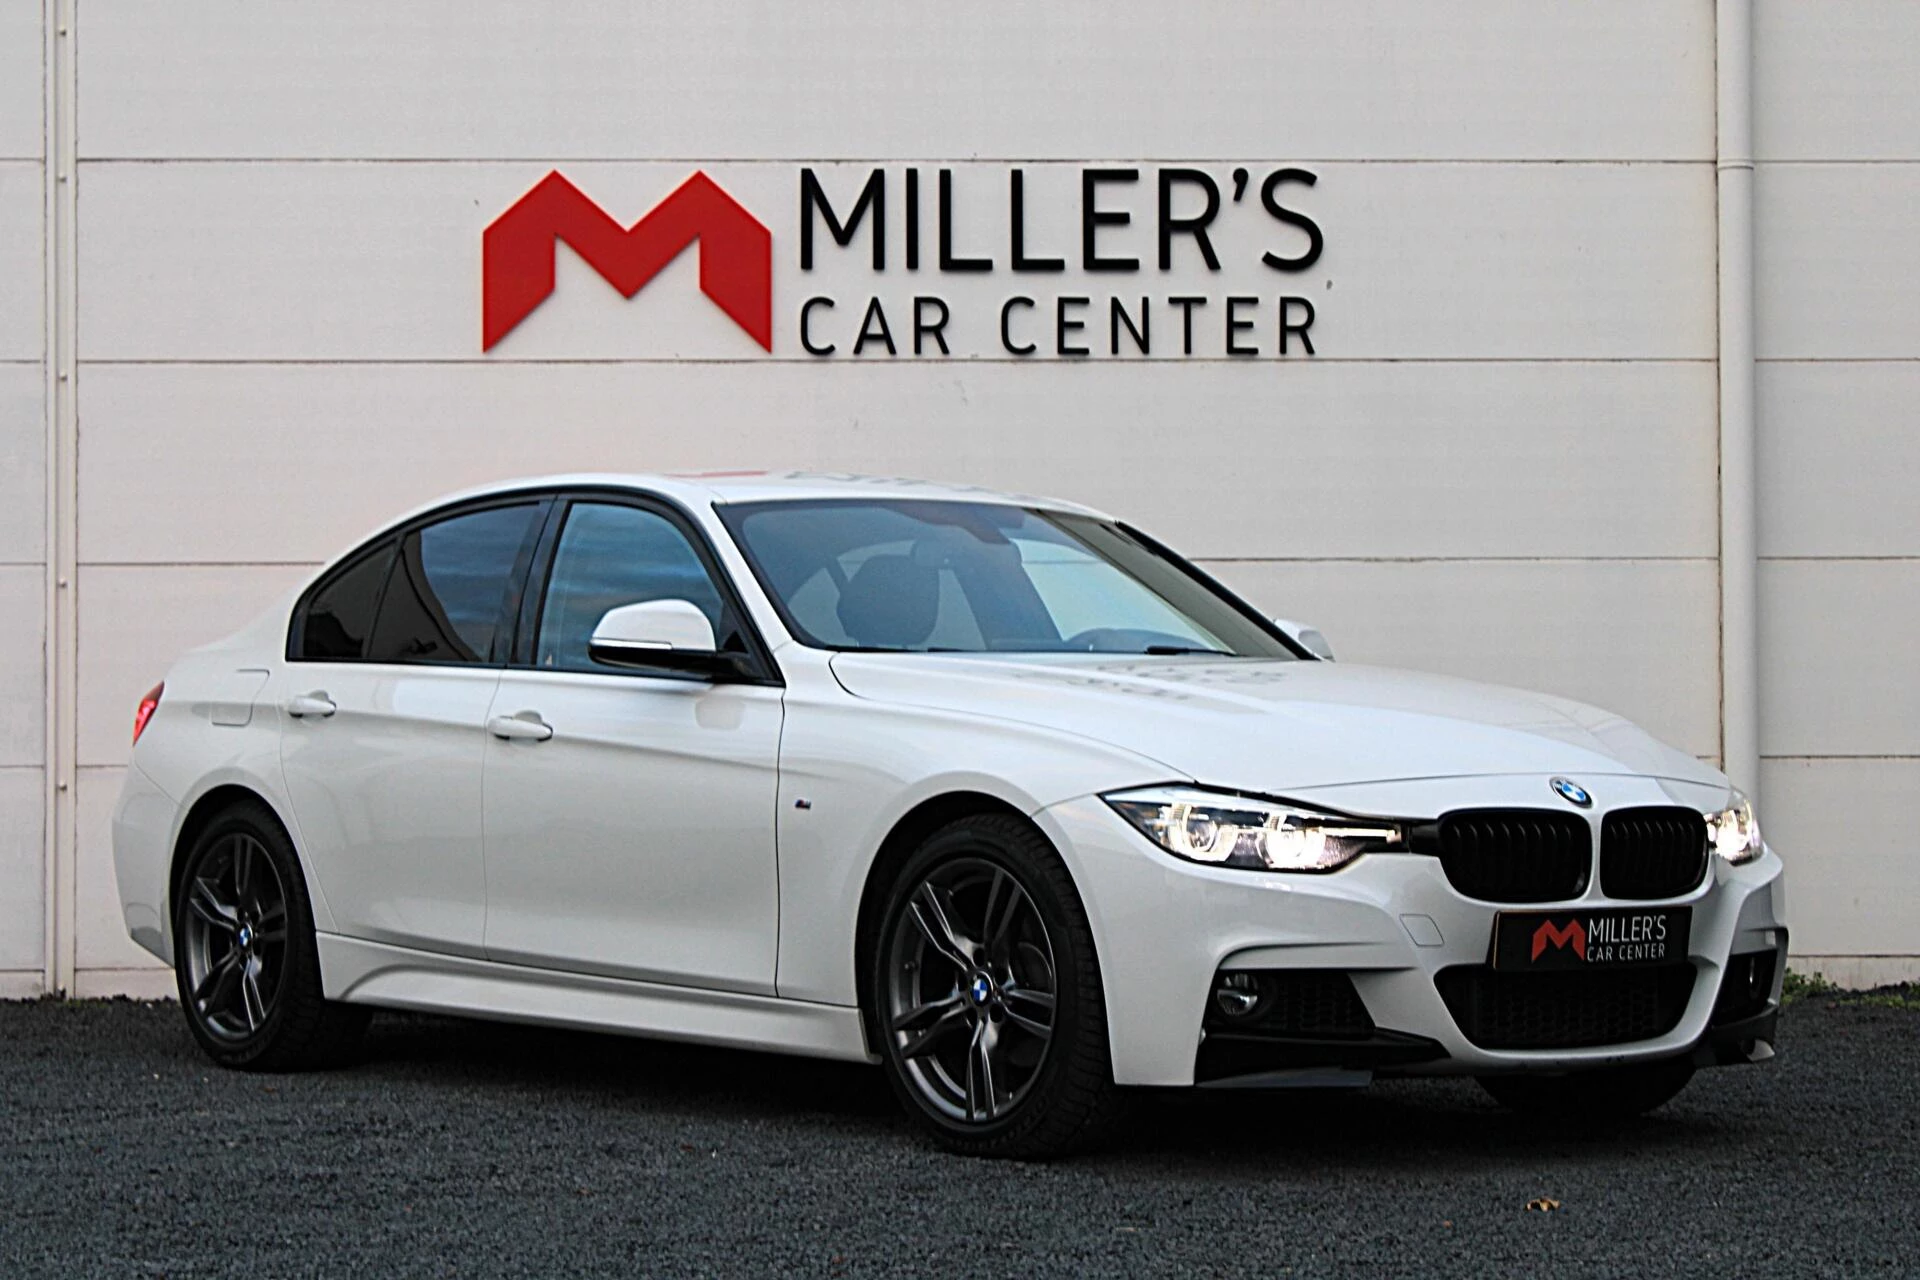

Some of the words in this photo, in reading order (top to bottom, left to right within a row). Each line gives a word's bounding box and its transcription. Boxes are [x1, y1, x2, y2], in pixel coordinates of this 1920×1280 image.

[801, 168, 1323, 272] MILLER'S
[801, 297, 949, 356] CAR
[1001, 297, 1315, 356] CENTER
[1588, 915, 1666, 944] MILLER'S
[1587, 946, 1613, 962] CAR
[1618, 943, 1665, 962] CENTER
